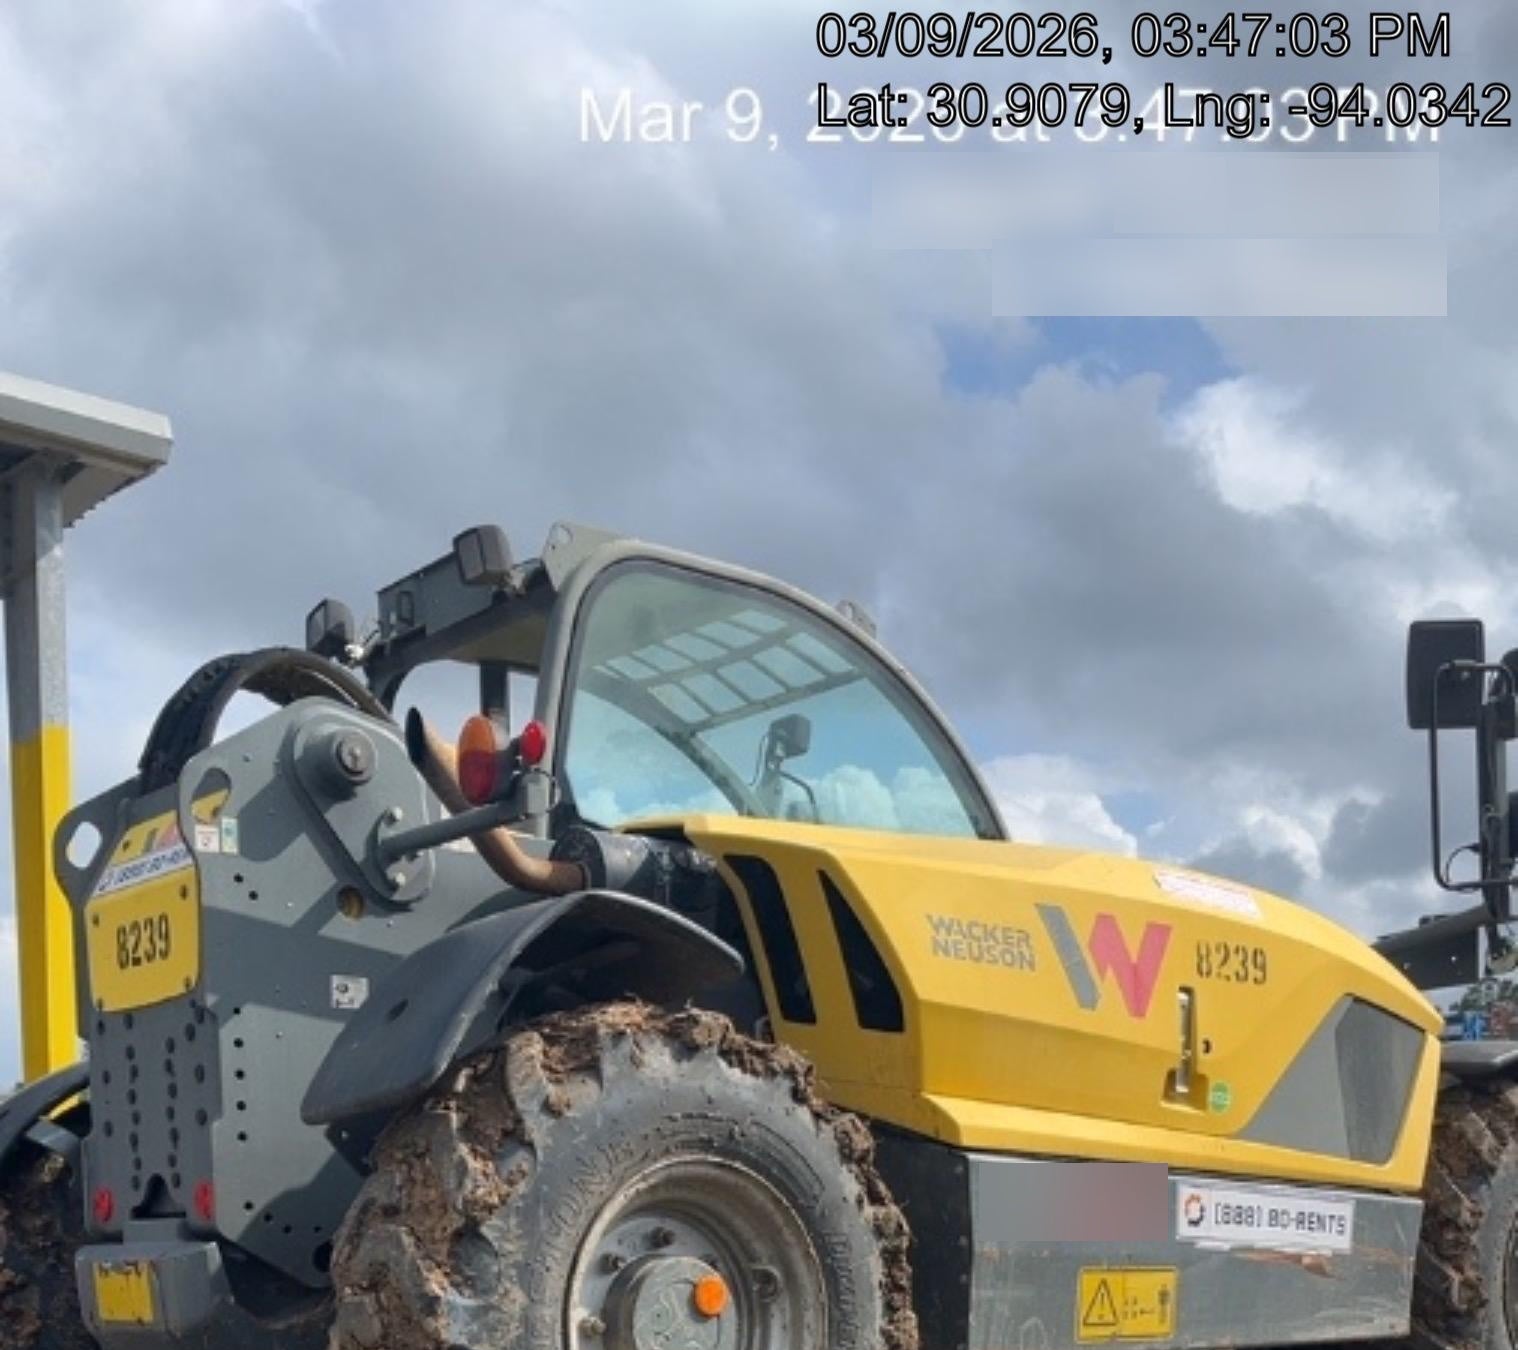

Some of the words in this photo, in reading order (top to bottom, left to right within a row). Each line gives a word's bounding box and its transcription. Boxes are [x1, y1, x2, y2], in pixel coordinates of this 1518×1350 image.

[116, 912, 171, 970] 8239
[926, 914, 1032, 950] WACKER
[932, 936, 1036, 972] NEUSON
[1195, 940, 1267, 985] 8239
